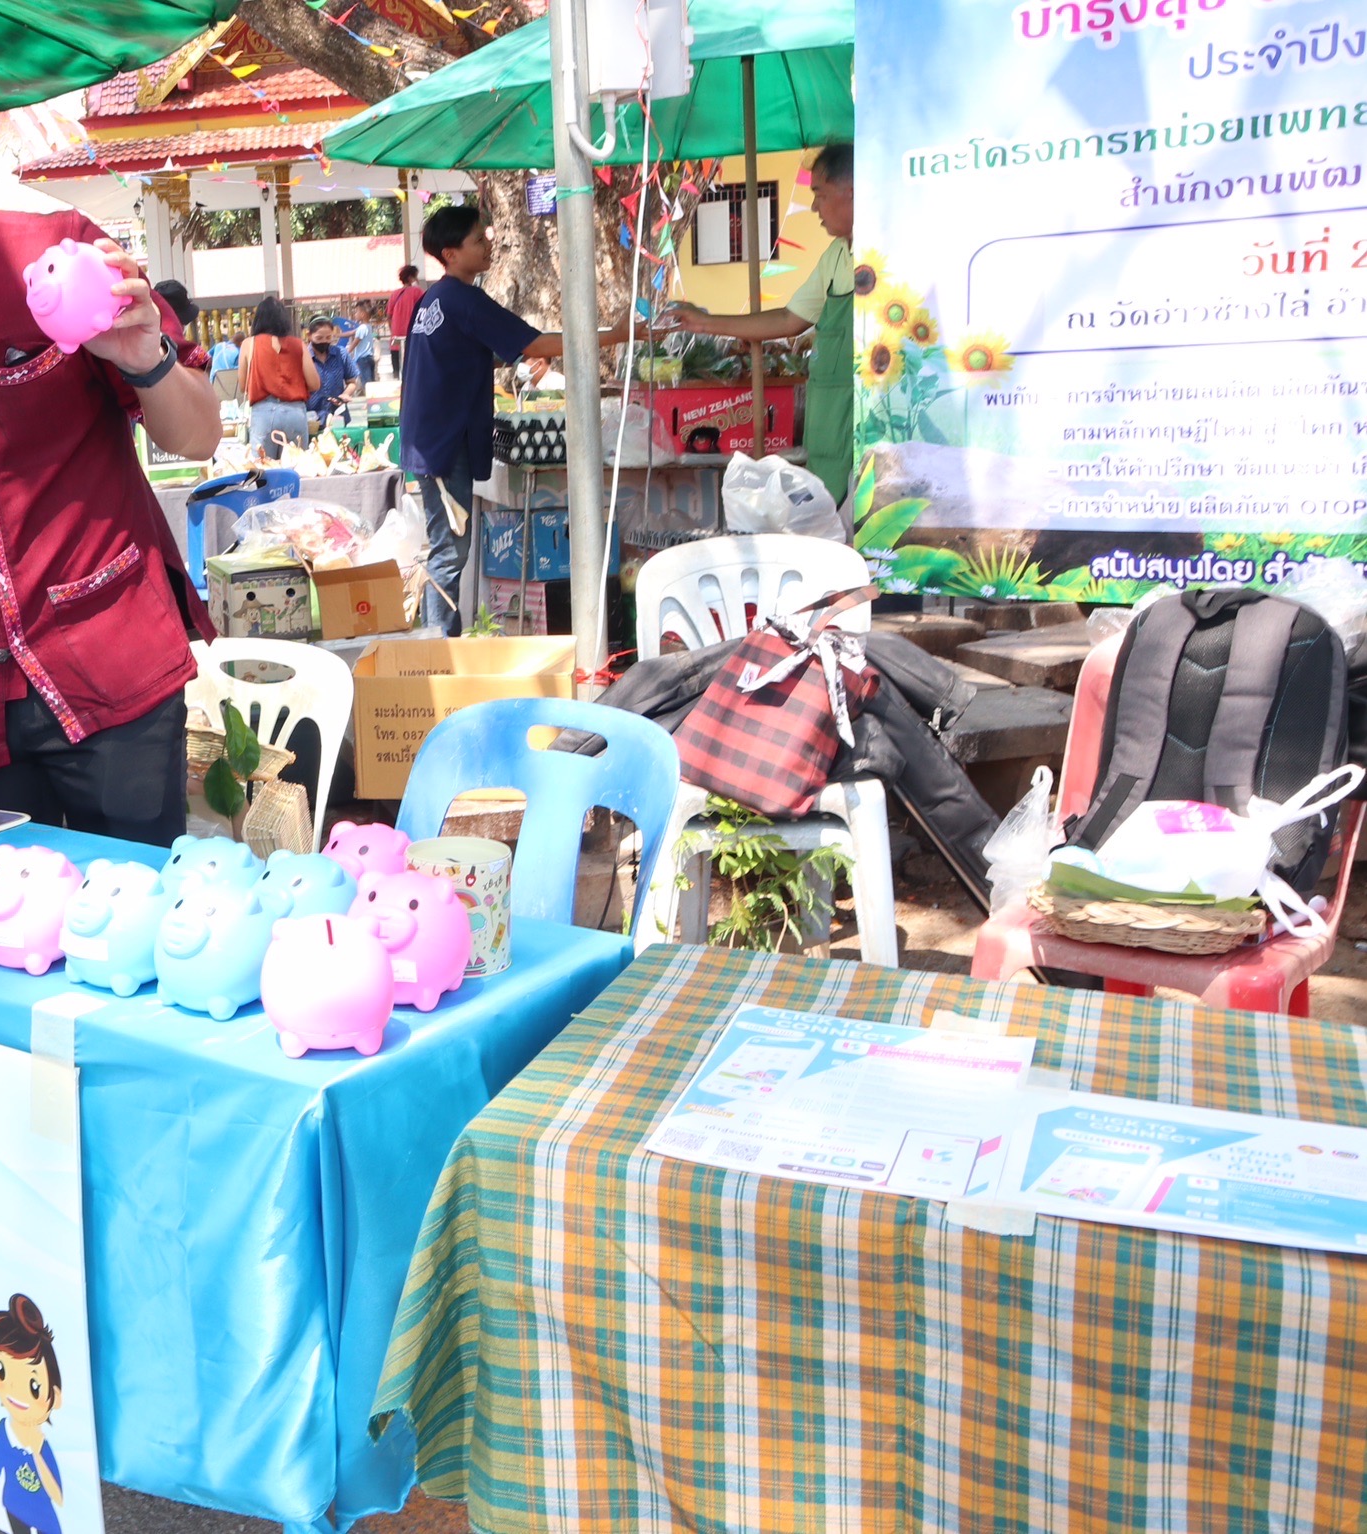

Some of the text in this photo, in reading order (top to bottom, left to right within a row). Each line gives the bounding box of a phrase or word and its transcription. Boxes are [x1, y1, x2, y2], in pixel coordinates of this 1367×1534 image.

[1242, 227, 1330, 275] วันที่
[1068, 311, 1095, 329] ณ
[683, 405, 707, 423] NEW
[730, 436, 788, 449] BOSOCK
[1090, 551, 1253, 586] สนับสนุนโดย
[375, 703, 436, 718] มะม่วงกวน
[374, 724, 399, 740] โทร.
[763, 1008, 875, 1031] CLICK TO
[775, 1020, 898, 1044] CONNECT
[1075, 1111, 1178, 1135] CLICK TO
[1088, 1121, 1201, 1146] CONNECT
